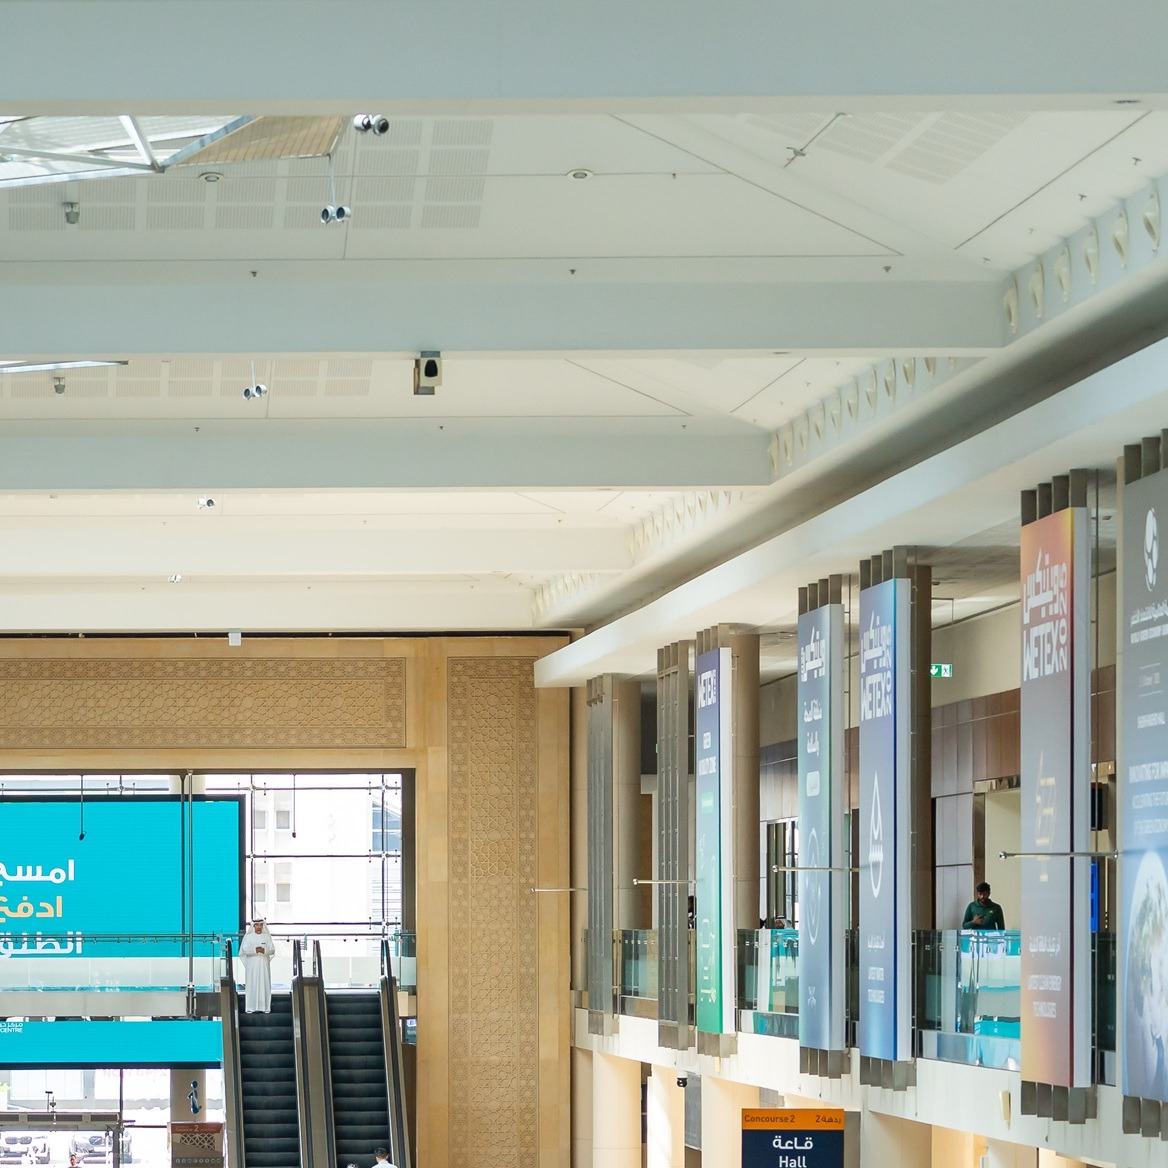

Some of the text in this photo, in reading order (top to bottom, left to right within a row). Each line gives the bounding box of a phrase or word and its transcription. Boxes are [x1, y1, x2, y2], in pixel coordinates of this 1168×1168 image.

[1023, 547, 1059, 625] ويتيكس
[1023, 620, 1060, 682] WETEX
[861, 672, 886, 721] WETEX
[744, 1114, 796, 1123] Concourse 2
[815, 1114, 821, 1123] 2
[193, 1124, 199, 1132] 2
[772, 1135, 814, 1150] قاعة
[778, 1155, 807, 1168] Hall
